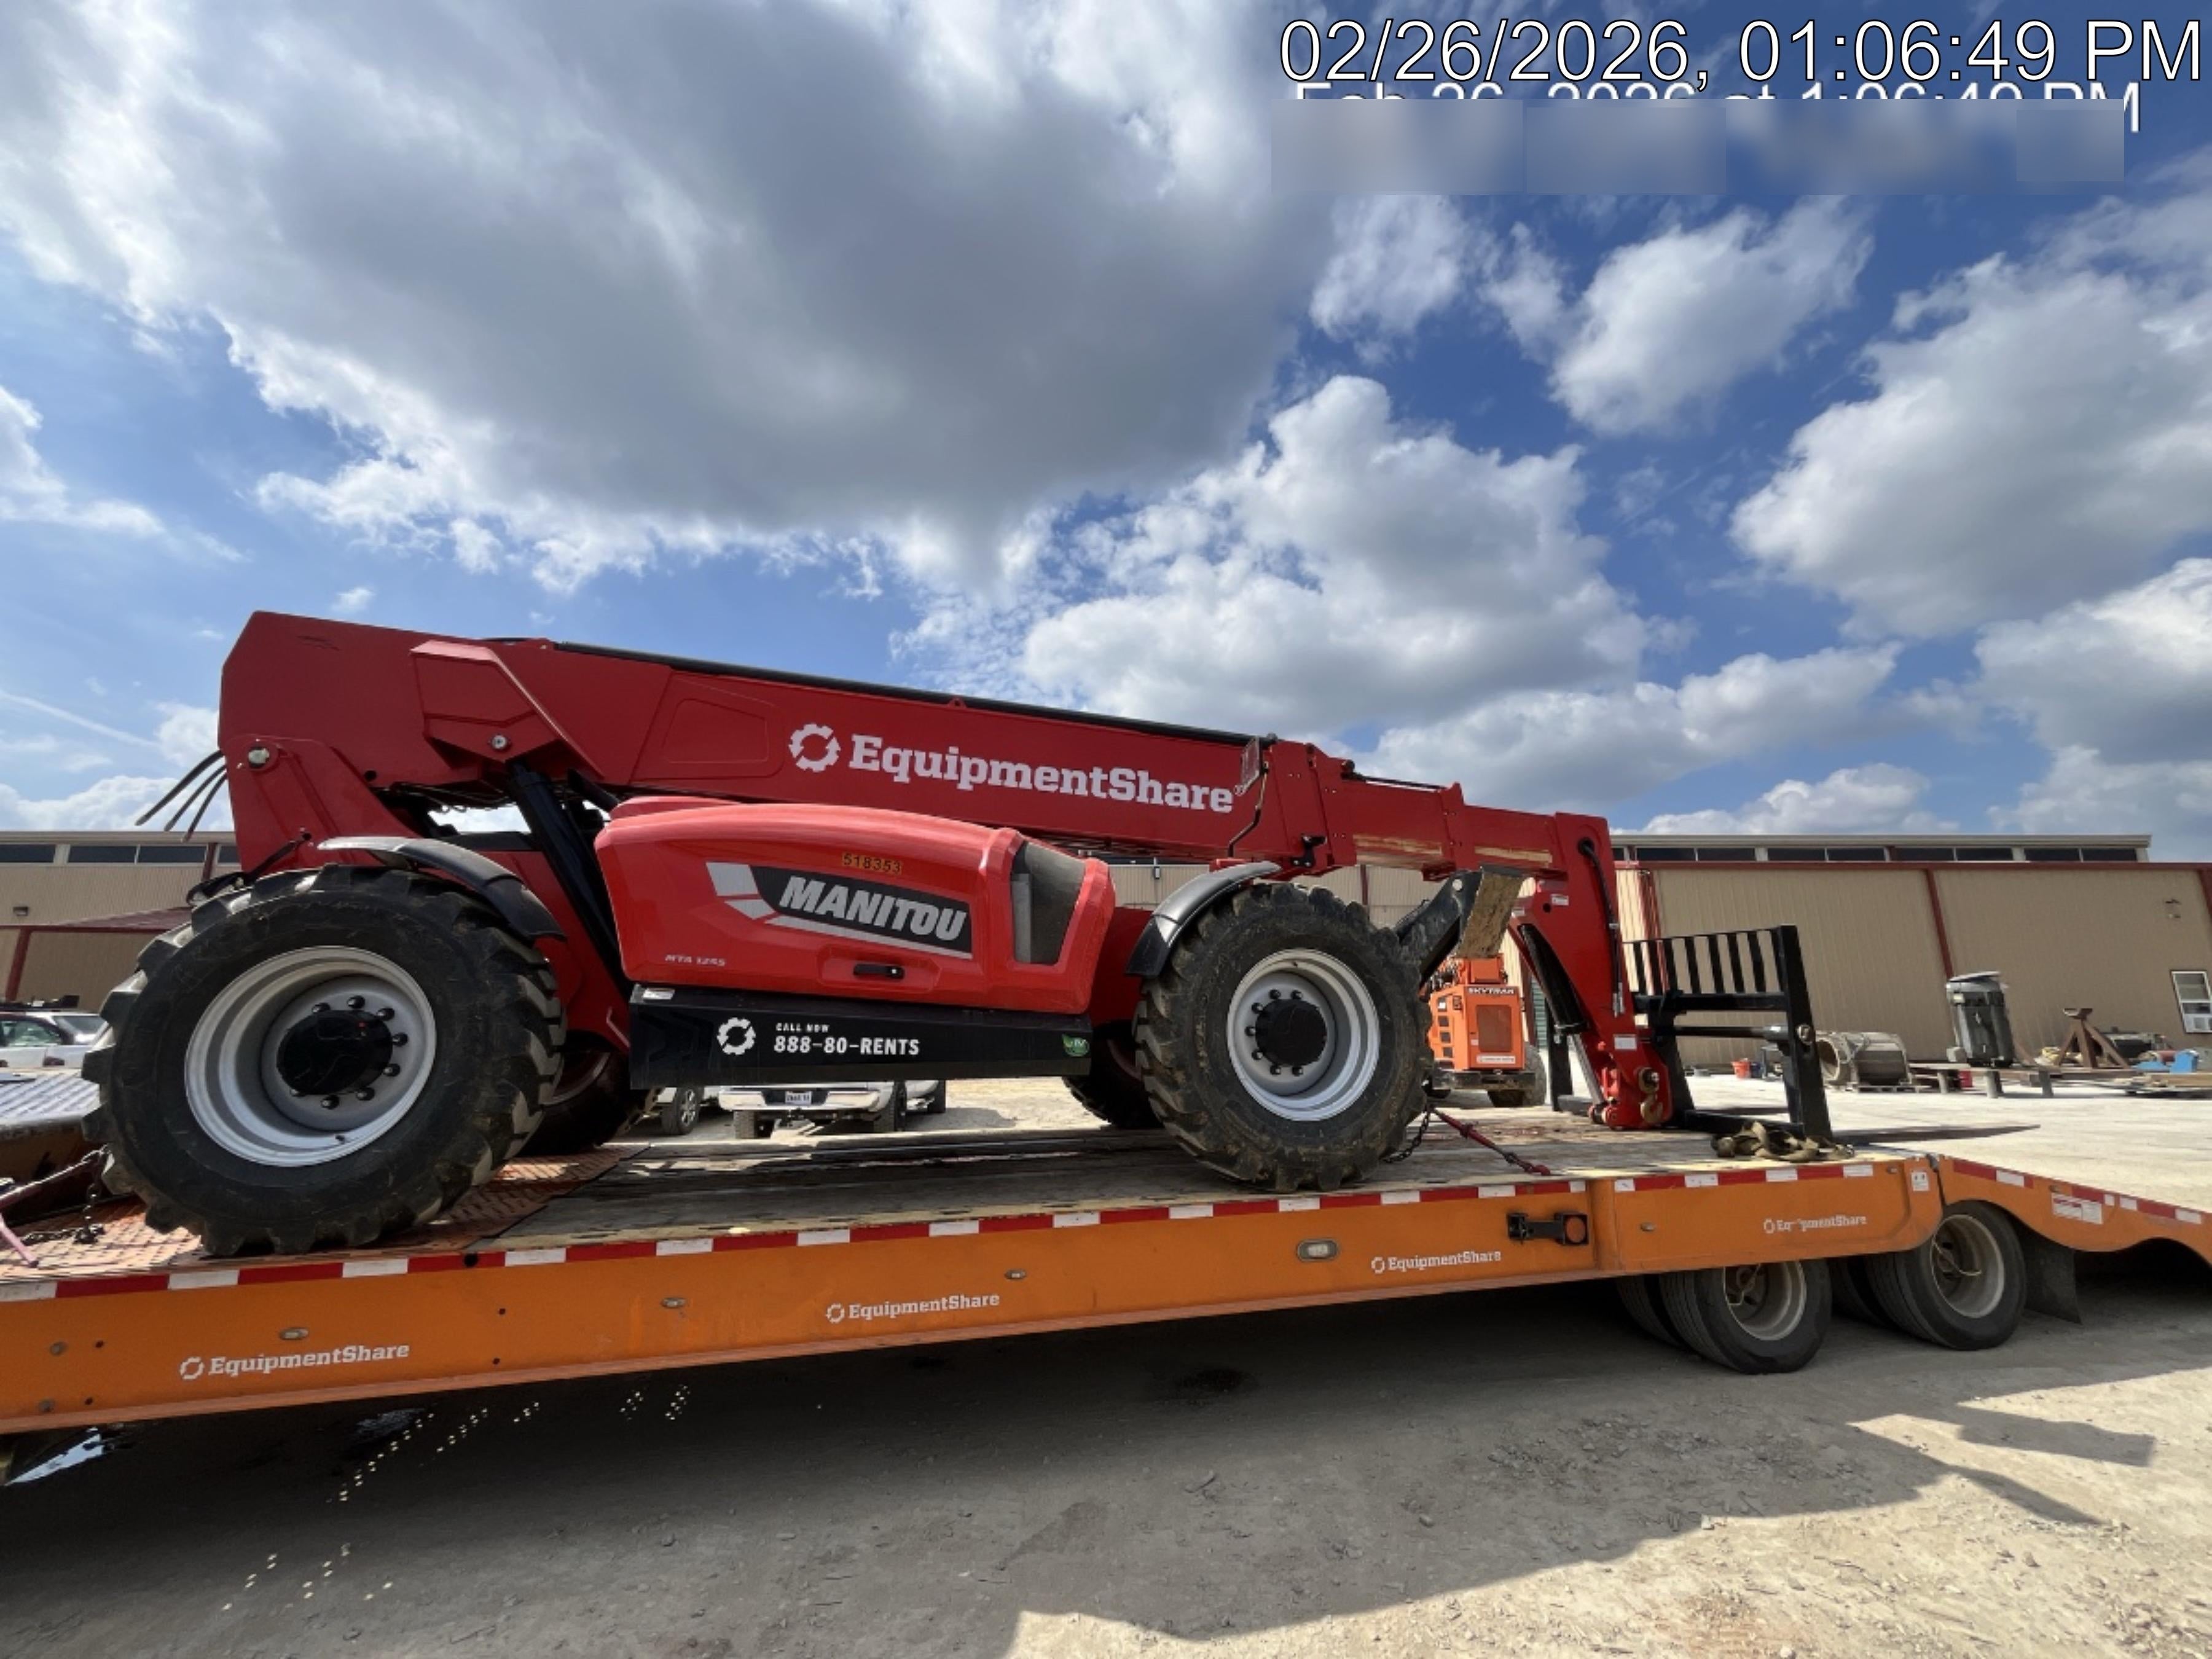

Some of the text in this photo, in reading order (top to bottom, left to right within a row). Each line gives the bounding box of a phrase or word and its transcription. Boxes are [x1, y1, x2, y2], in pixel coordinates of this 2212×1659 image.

[849, 734, 1233, 813] EquipmentShare
[779, 875, 967, 941] MANITOU
[775, 1022, 801, 1032] CALL
[774, 1035, 920, 1056] 888-80-RENTS
[1776, 1214, 1868, 1232] EqpmentShare
[1388, 1250, 1502, 1273] EquipmentShare
[849, 1293, 1000, 1320] EquipmentShare
[208, 1344, 410, 1377] EquipmentShare
